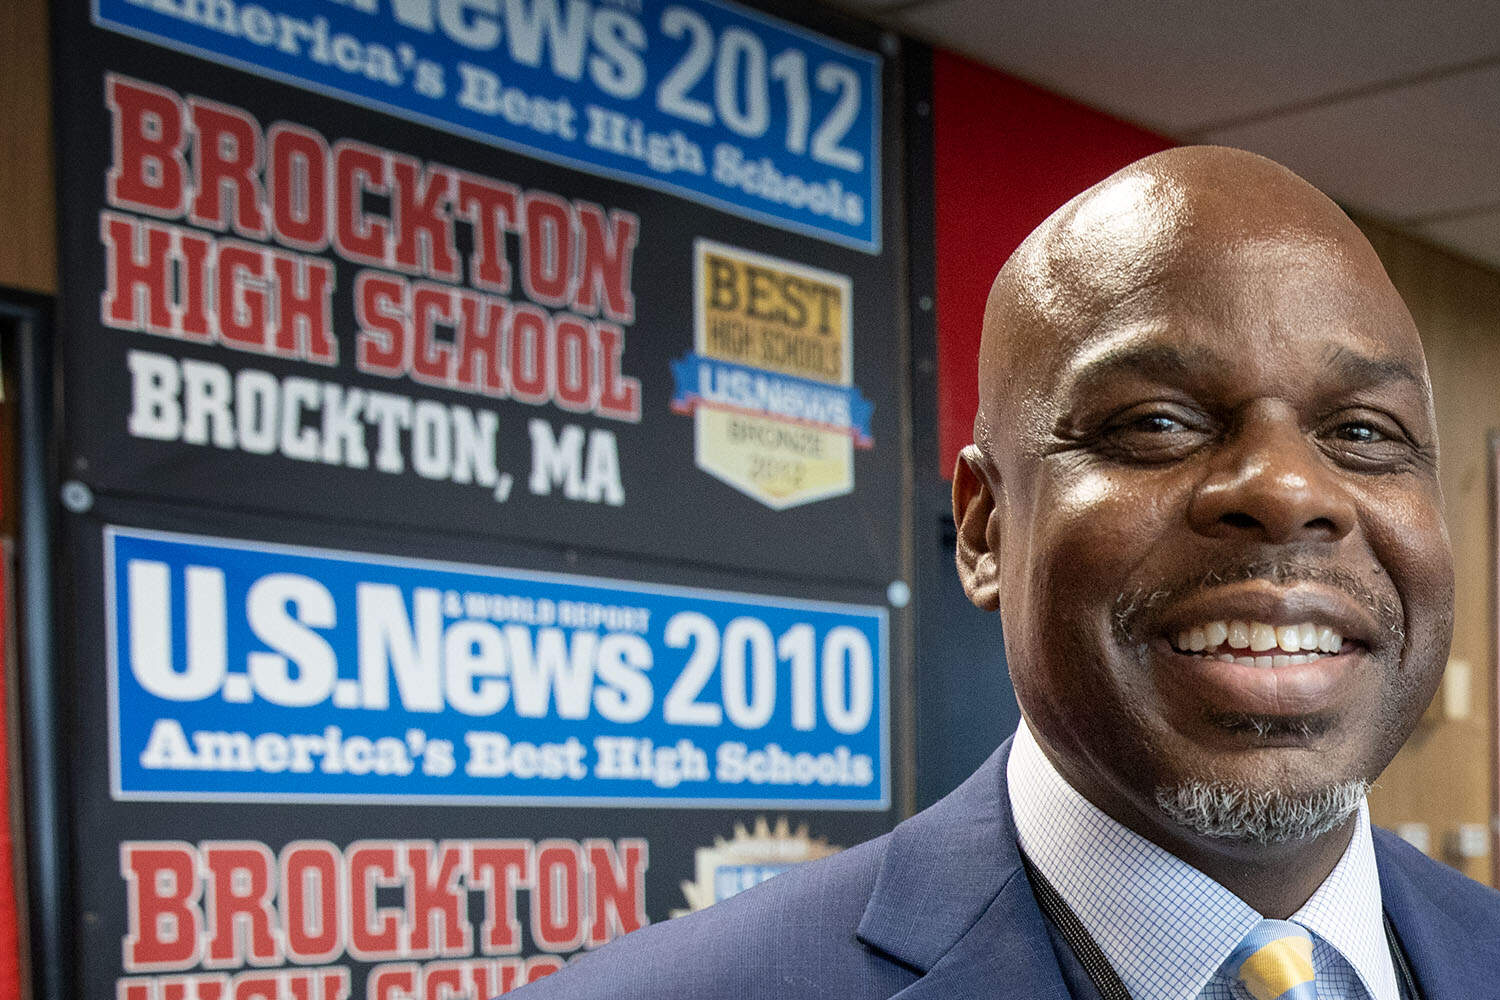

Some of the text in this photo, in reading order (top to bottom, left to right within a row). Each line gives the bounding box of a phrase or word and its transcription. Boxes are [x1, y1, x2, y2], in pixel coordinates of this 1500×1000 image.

[118, 0, 865, 227] merica's Best High Schools
[338, 0, 864, 173] ews 2012
[104, 69, 640, 326] BROCKTON
[100, 210, 642, 424] HIGH SCHOOL
[708, 255, 843, 337] BEST
[711, 316, 842, 384] HIGH SCHOOLS
[127, 349, 626, 507] BROCKTON, MA
[463, 590, 556, 628] WORLD
[558, 599, 650, 635] REPORT
[662, 610, 874, 735] 2010
[139, 717, 874, 789] America's Best High Schools
[120, 837, 650, 974] BROCKTON
